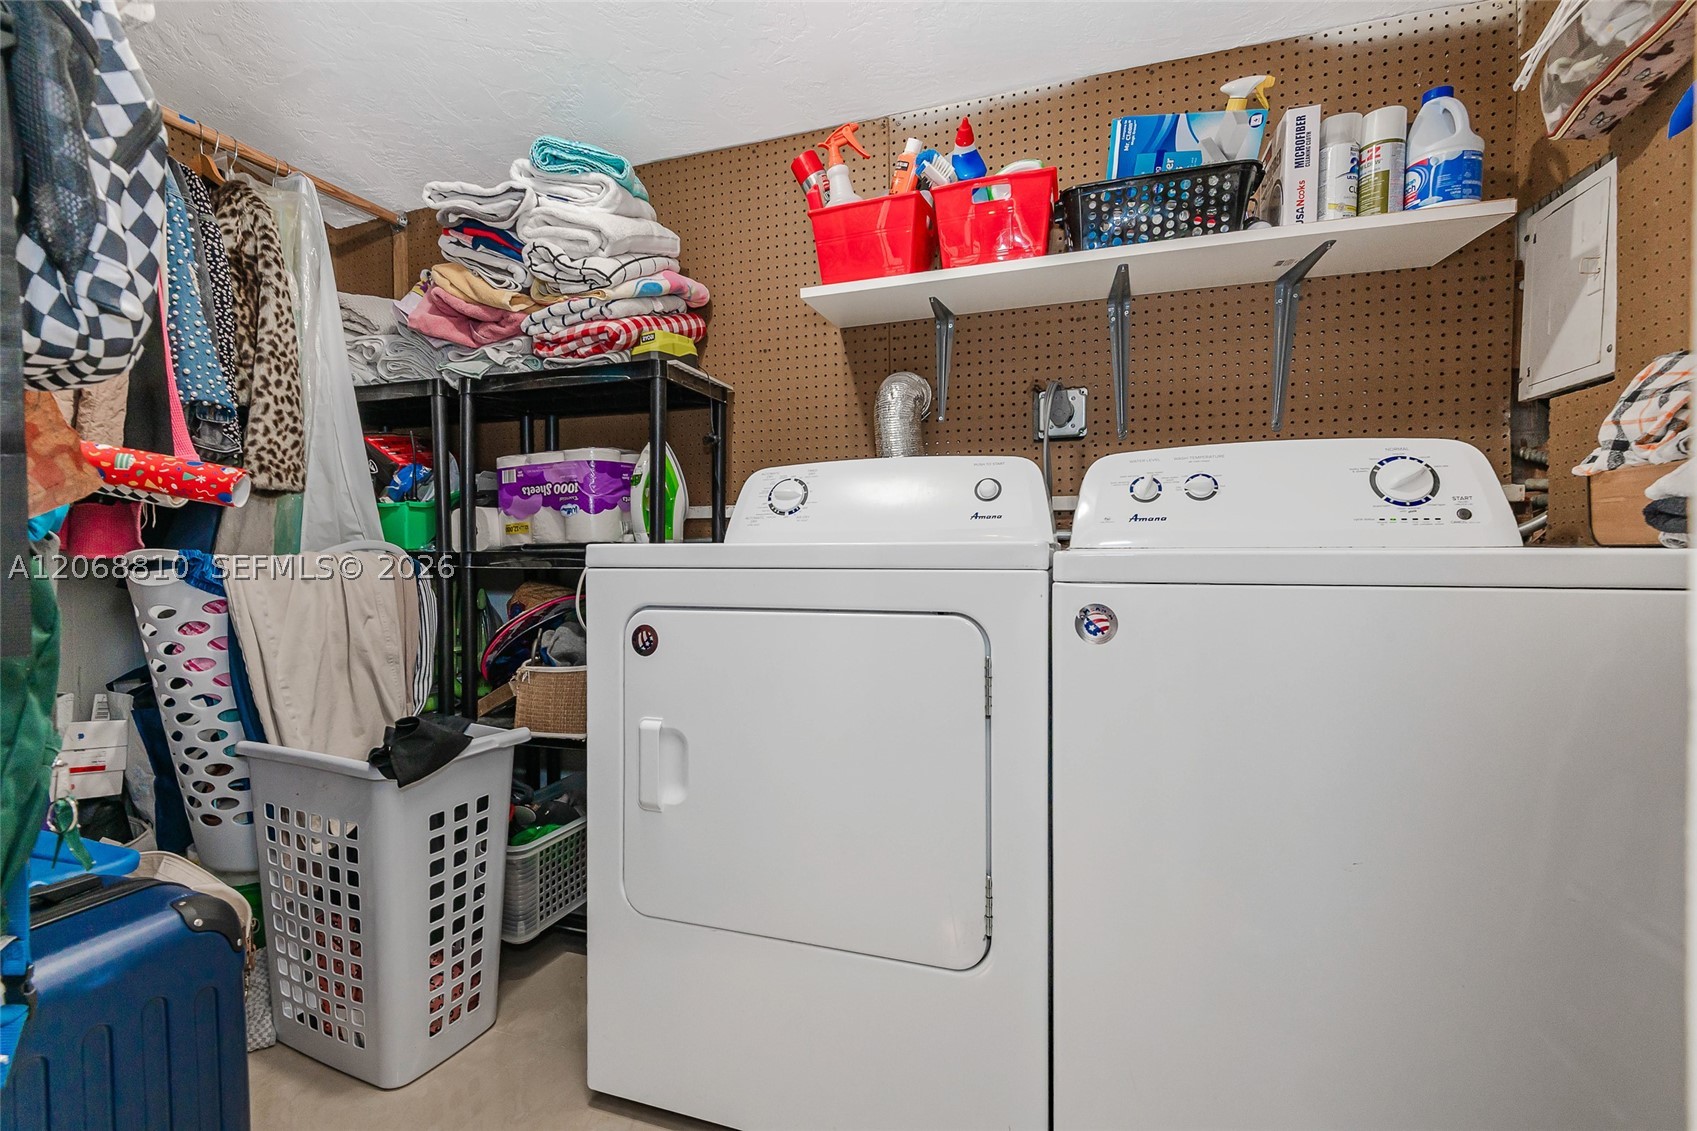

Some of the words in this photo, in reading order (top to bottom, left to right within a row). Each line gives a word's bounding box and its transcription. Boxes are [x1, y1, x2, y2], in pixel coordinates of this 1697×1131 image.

[1294, 114, 1306, 169] MICROFIBER
[521, 484, 552, 496] Sheets
[554, 482, 579, 494] 1000
[969, 511, 1003, 521] Amana
[1128, 513, 1168, 523] Amana
